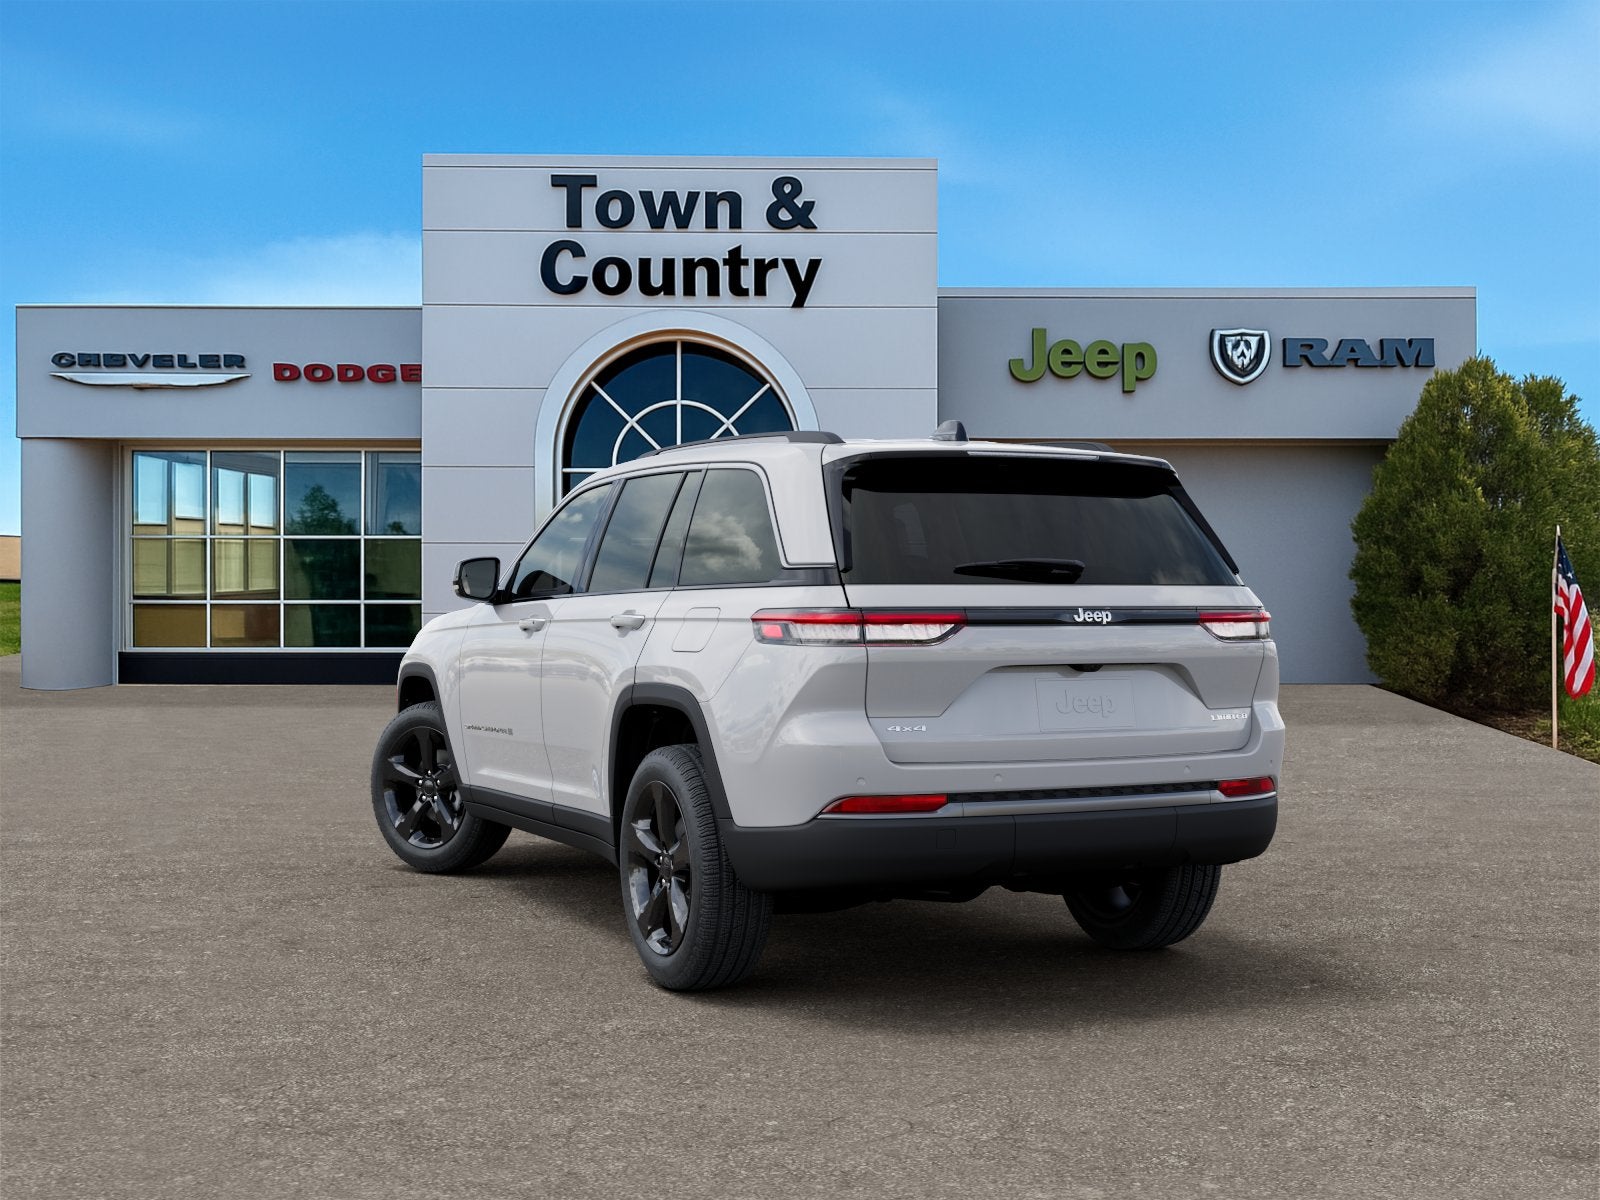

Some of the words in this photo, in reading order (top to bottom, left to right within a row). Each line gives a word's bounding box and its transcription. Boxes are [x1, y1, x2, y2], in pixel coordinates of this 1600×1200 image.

[551, 174, 742, 229] Town
[765, 176, 818, 229] &
[540, 239, 822, 308] Country
[1009, 328, 1158, 393] Jeep
[1282, 337, 1435, 368] RAM
[273, 363, 422, 383] DODGE
[1073, 607, 1112, 624] Jeep
[1056, 688, 1116, 718] Jeep
